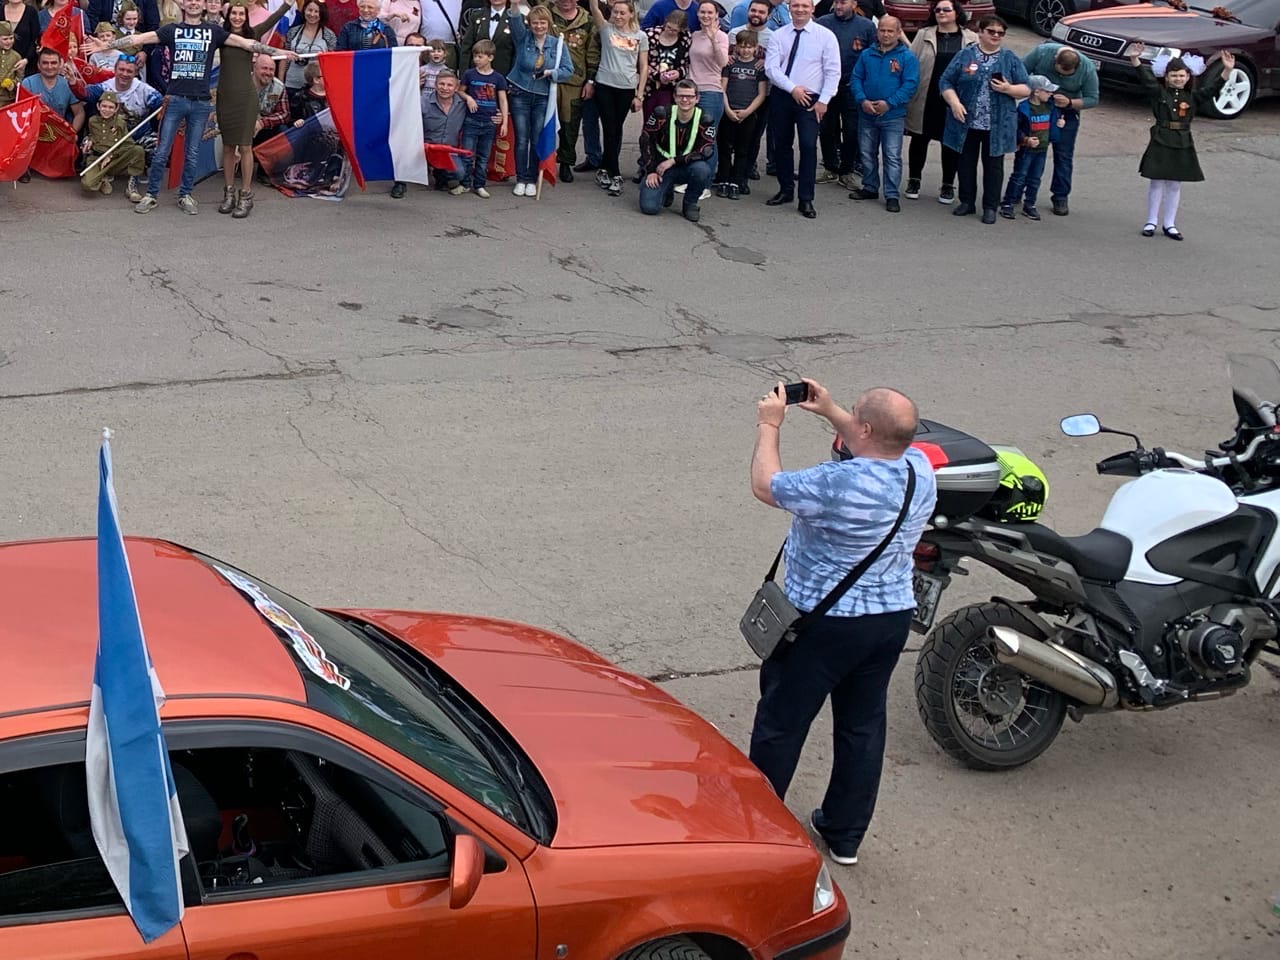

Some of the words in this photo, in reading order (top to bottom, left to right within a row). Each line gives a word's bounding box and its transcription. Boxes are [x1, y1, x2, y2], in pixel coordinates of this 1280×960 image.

[175, 28, 212, 40] PUSH
[174, 50, 194, 61] CAN
[732, 67, 756, 75] GUCCI
